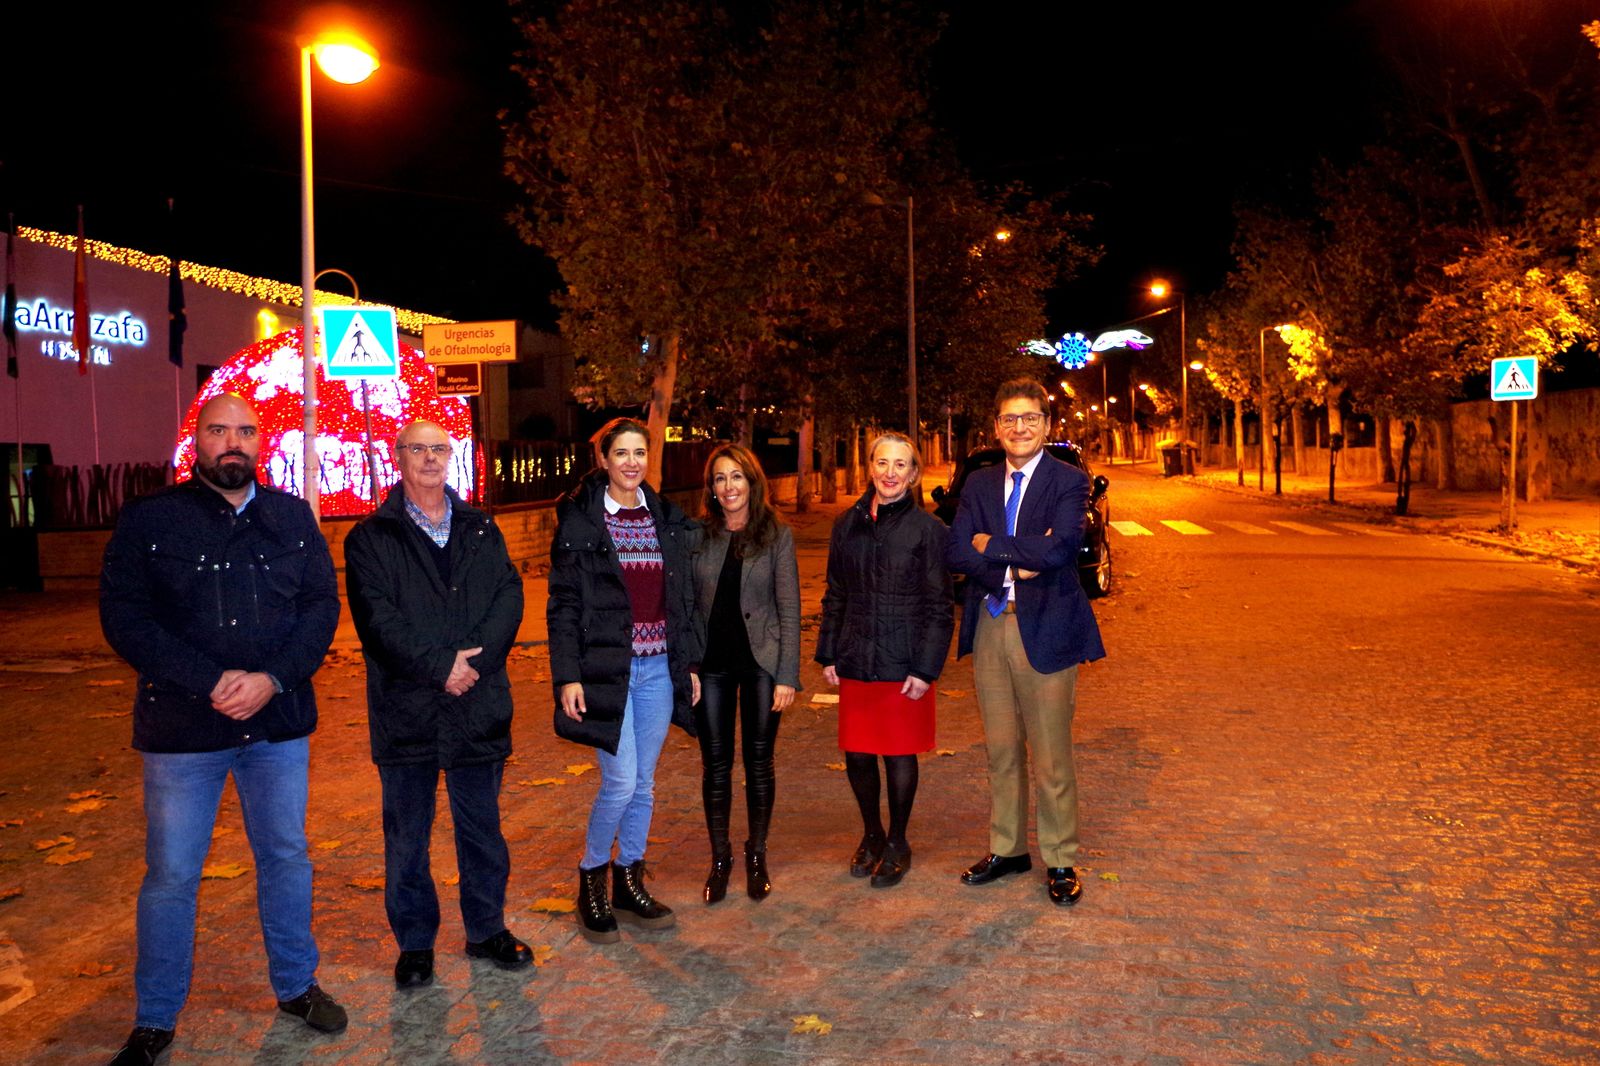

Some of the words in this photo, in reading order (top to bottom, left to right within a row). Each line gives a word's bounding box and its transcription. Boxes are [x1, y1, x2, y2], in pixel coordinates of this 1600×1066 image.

[2, 300, 146, 344] aArrzafa
[444, 327, 495, 342] Urgencias
[429, 345, 442, 356] de
[444, 343, 511, 356] Oftalmología
